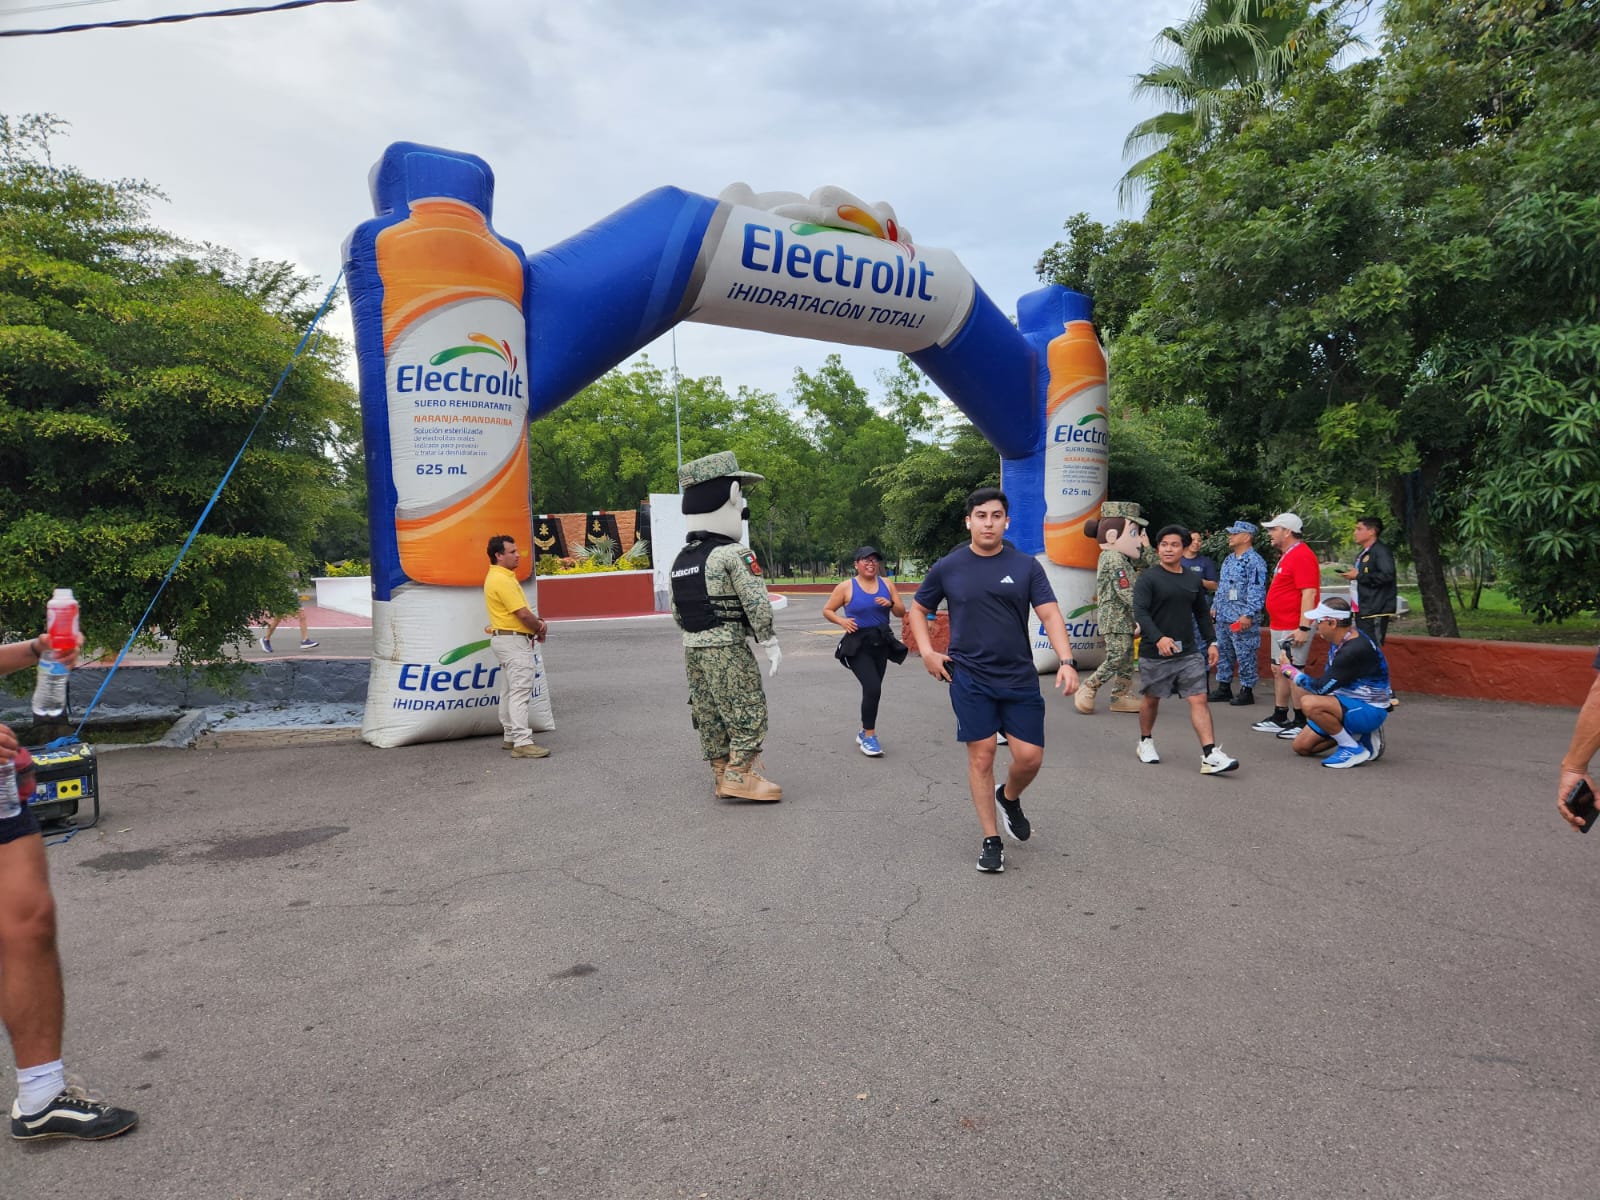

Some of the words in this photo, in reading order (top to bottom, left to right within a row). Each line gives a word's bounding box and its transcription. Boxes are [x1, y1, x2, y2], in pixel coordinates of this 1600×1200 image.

[741, 222, 935, 302] Electrolit
[726, 281, 866, 321] ¡HIDRATACIÓN
[867, 306, 926, 330] TOTAL!
[396, 364, 523, 399] Electrolit
[414, 399, 447, 409] SUERO
[449, 400, 513, 412] REHIDRATANTE
[416, 463, 443, 475] 625
[447, 463, 468, 475] mL
[1062, 487, 1079, 496] 625
[1081, 487, 1093, 496] mL
